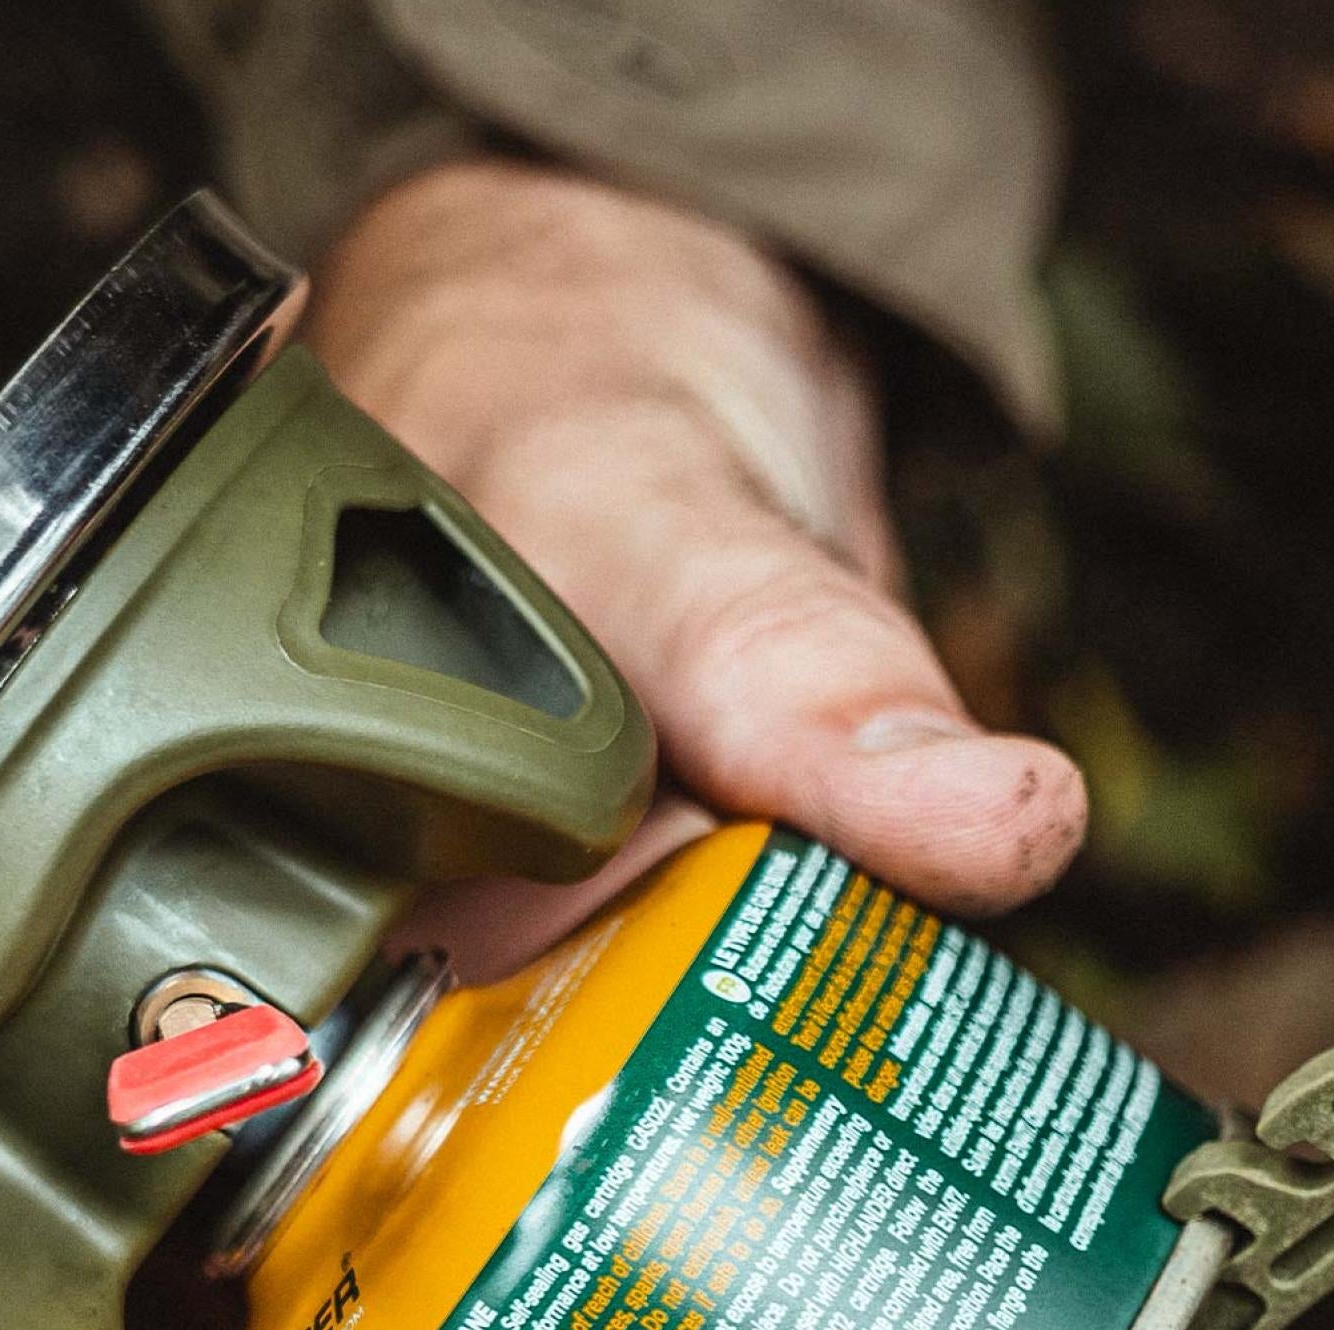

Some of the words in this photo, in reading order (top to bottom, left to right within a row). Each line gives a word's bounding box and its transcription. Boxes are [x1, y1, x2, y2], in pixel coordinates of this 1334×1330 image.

[669, 1106, 699, 1137] Net
[687, 1061, 731, 1112] weight:
[716, 1031, 755, 1069] 100g.
[562, 1220, 591, 1253] gas
[583, 1153, 638, 1219] cartridge
[666, 1036, 713, 1095] Contains
[581, 1275, 620, 1318] reach
[703, 1044, 772, 1137] well-ventilated
[759, 1123, 791, 1158] leak
[764, 1175, 831, 1263] temperature
[818, 1112, 872, 1180] exceeding
[770, 1095, 847, 1198] Supplementary
[623, 1254, 673, 1311] sparks,
[732, 1109, 765, 1148] other
[809, 1146, 884, 1252] puncture/pierce
[829, 1183, 896, 1276] HIGHLANDER
[883, 1148, 918, 1190] direct
[962, 1205, 995, 1243] from
[845, 1245, 900, 1314] cartridge.
[888, 1195, 927, 1243] Follow
[879, 1253, 932, 1325] complied
[917, 1226, 947, 1261] with
[932, 1185, 969, 1232] EN417.
[932, 1267, 966, 1303] area,
[947, 1237, 978, 1270] free
[976, 1246, 1010, 1284] Pace
